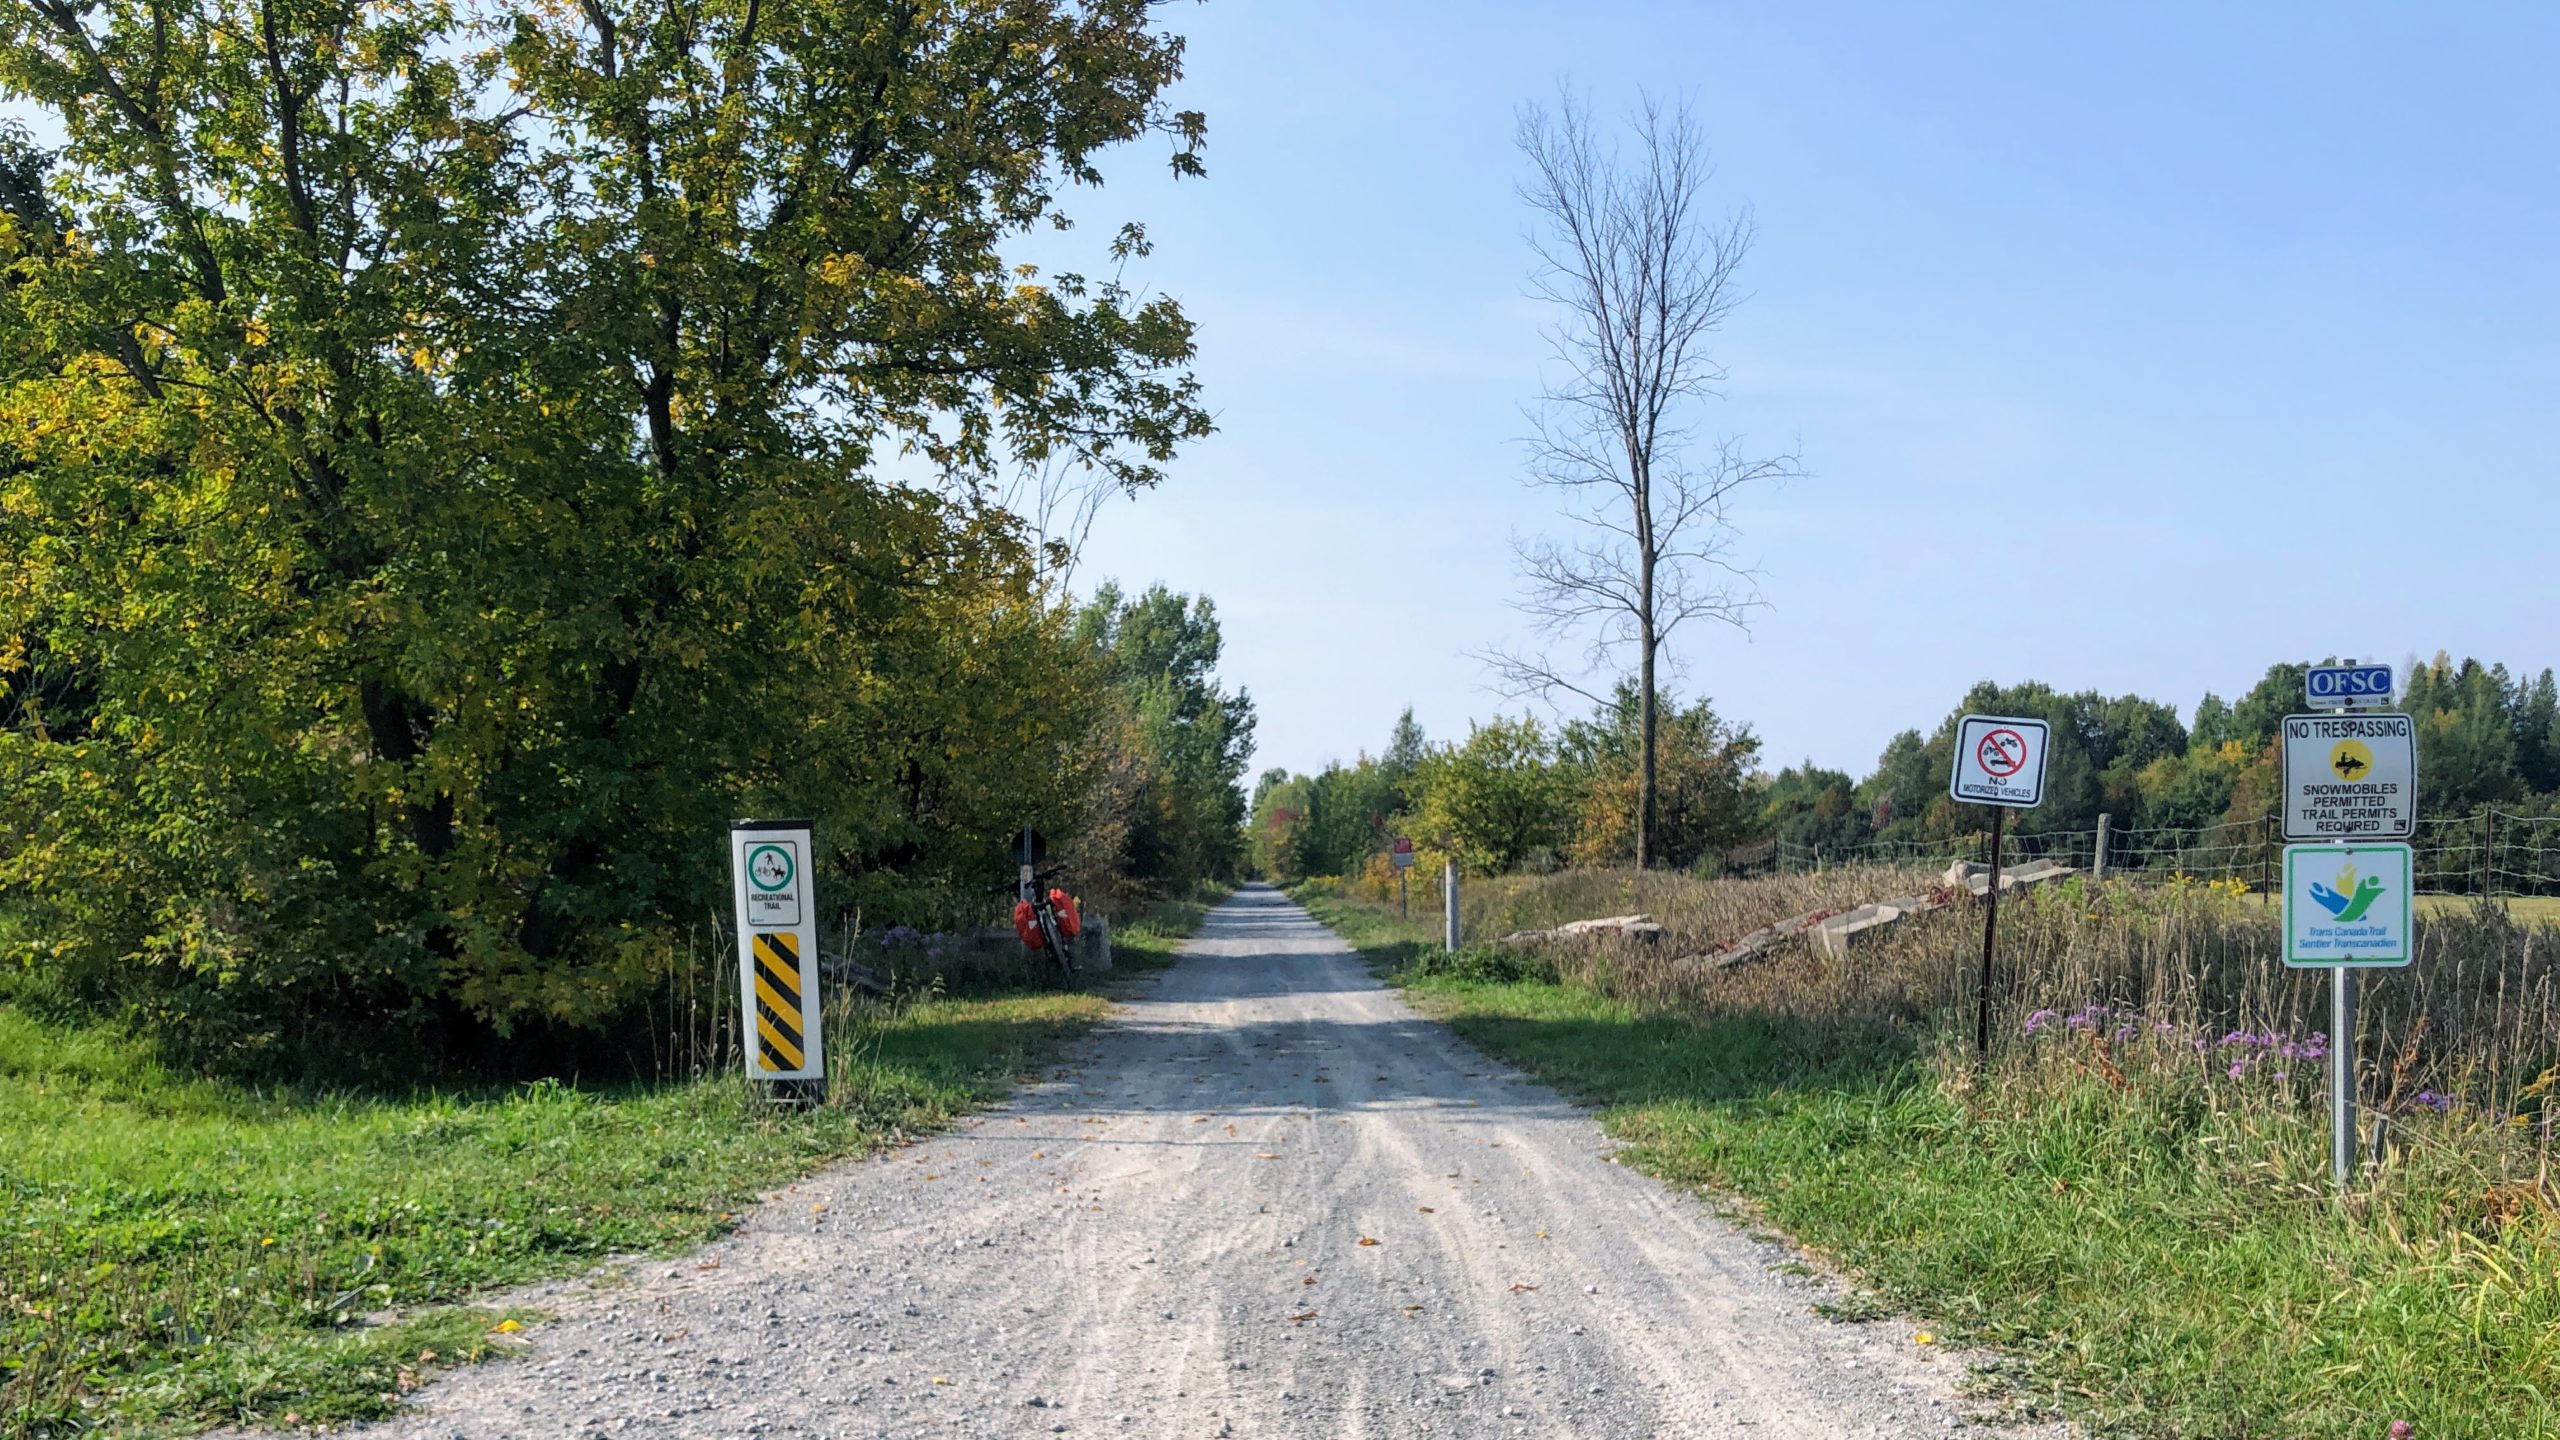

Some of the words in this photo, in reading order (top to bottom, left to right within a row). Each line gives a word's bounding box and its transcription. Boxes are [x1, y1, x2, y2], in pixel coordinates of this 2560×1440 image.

[2312, 671, 2387, 693] OFSC
[2289, 722, 2309, 739] NO
[2313, 720, 2407, 738] TRESPASSING
[1989, 777, 2007, 785] NO
[1963, 784, 1998, 795] MOTORIZED
[2001, 788, 2031, 798] VEHICLES
[2303, 784, 2397, 795] SNOWMOBILES
[2313, 796, 2385, 807] PERMITTED
[2302, 808, 2338, 820] TRAIL
[2342, 807, 2398, 819] PERMITS
[2316, 820, 2380, 832] REQUIRED
[2309, 927, 2332, 936] Trans
[2334, 926, 2368, 936] Canada
[2369, 926, 2386, 936] Trail
[2299, 939, 2331, 948] Sentier
[2333, 938, 2397, 948] Transcanadien
